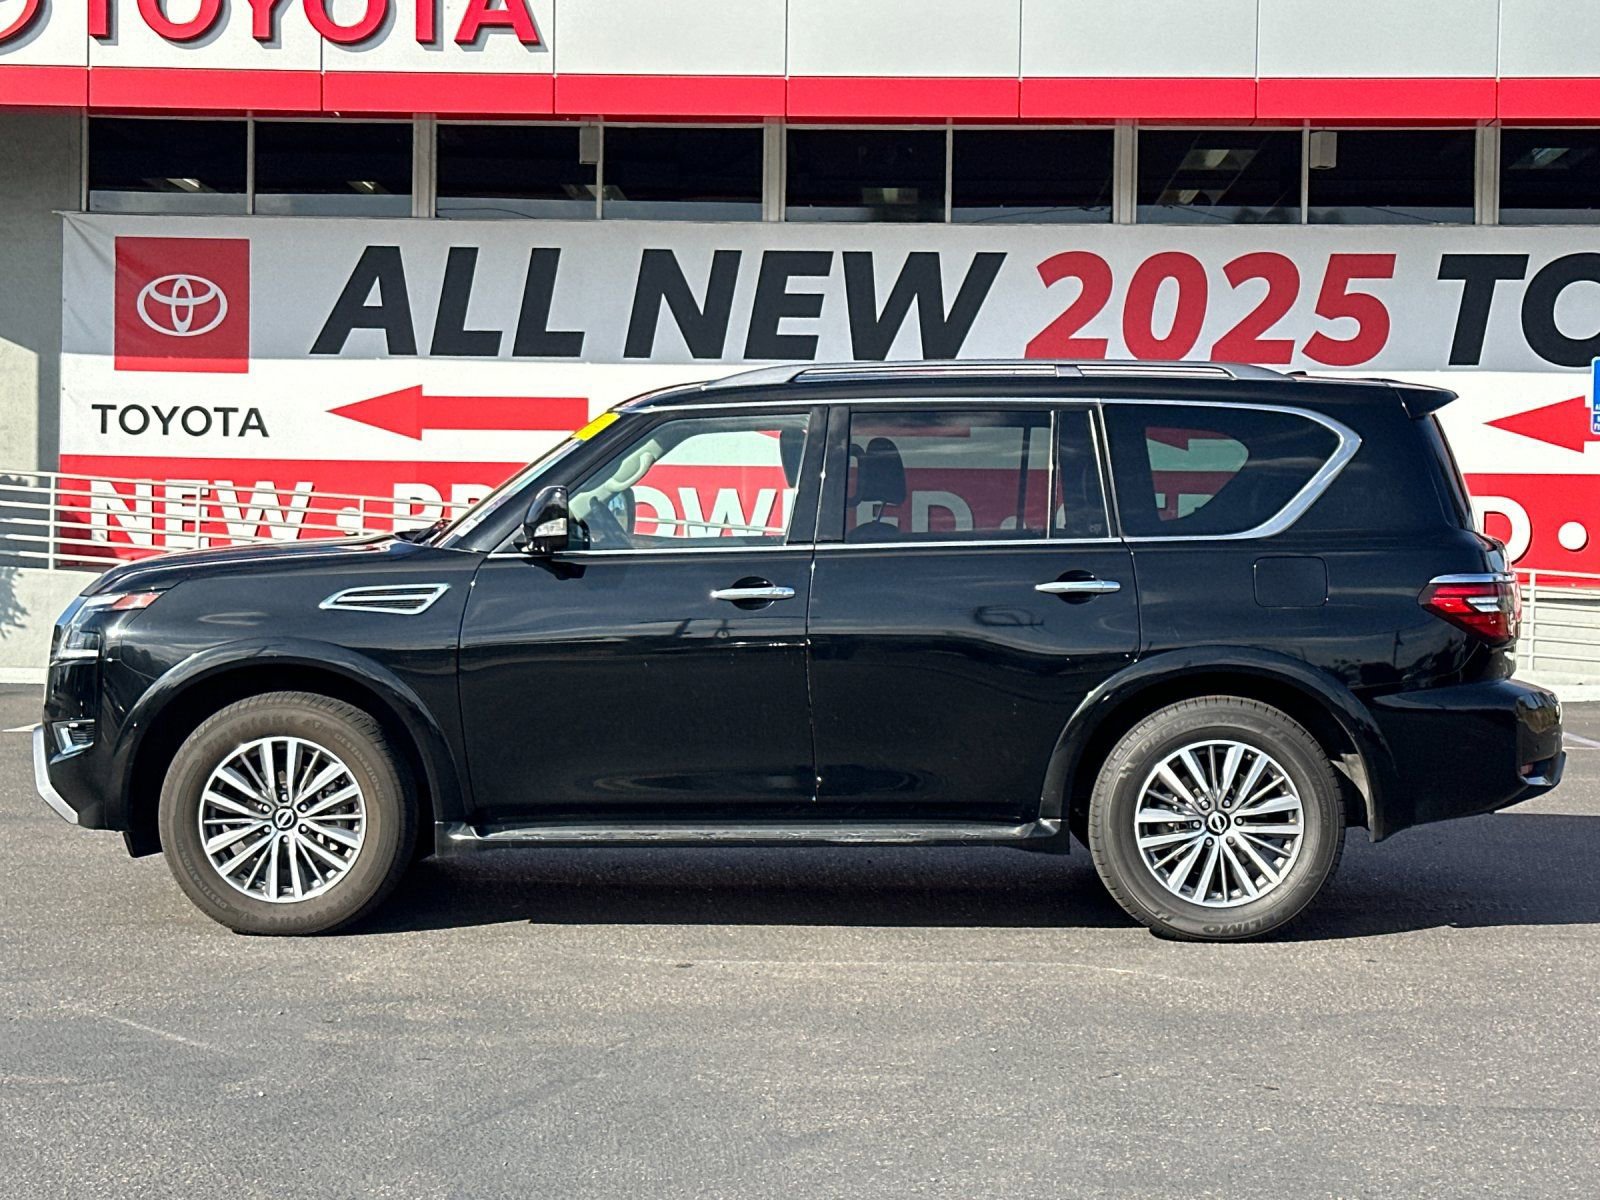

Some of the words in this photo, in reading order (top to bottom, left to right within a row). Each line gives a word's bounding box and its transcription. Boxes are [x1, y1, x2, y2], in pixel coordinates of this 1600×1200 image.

[309, 246, 586, 357] ALL
[623, 248, 1007, 360] NEW
[1025, 251, 1397, 367] 2025
[1437, 252, 1600, 368] TO
[91, 404, 270, 438] TOYOTA
[91, 478, 314, 548] NEW
